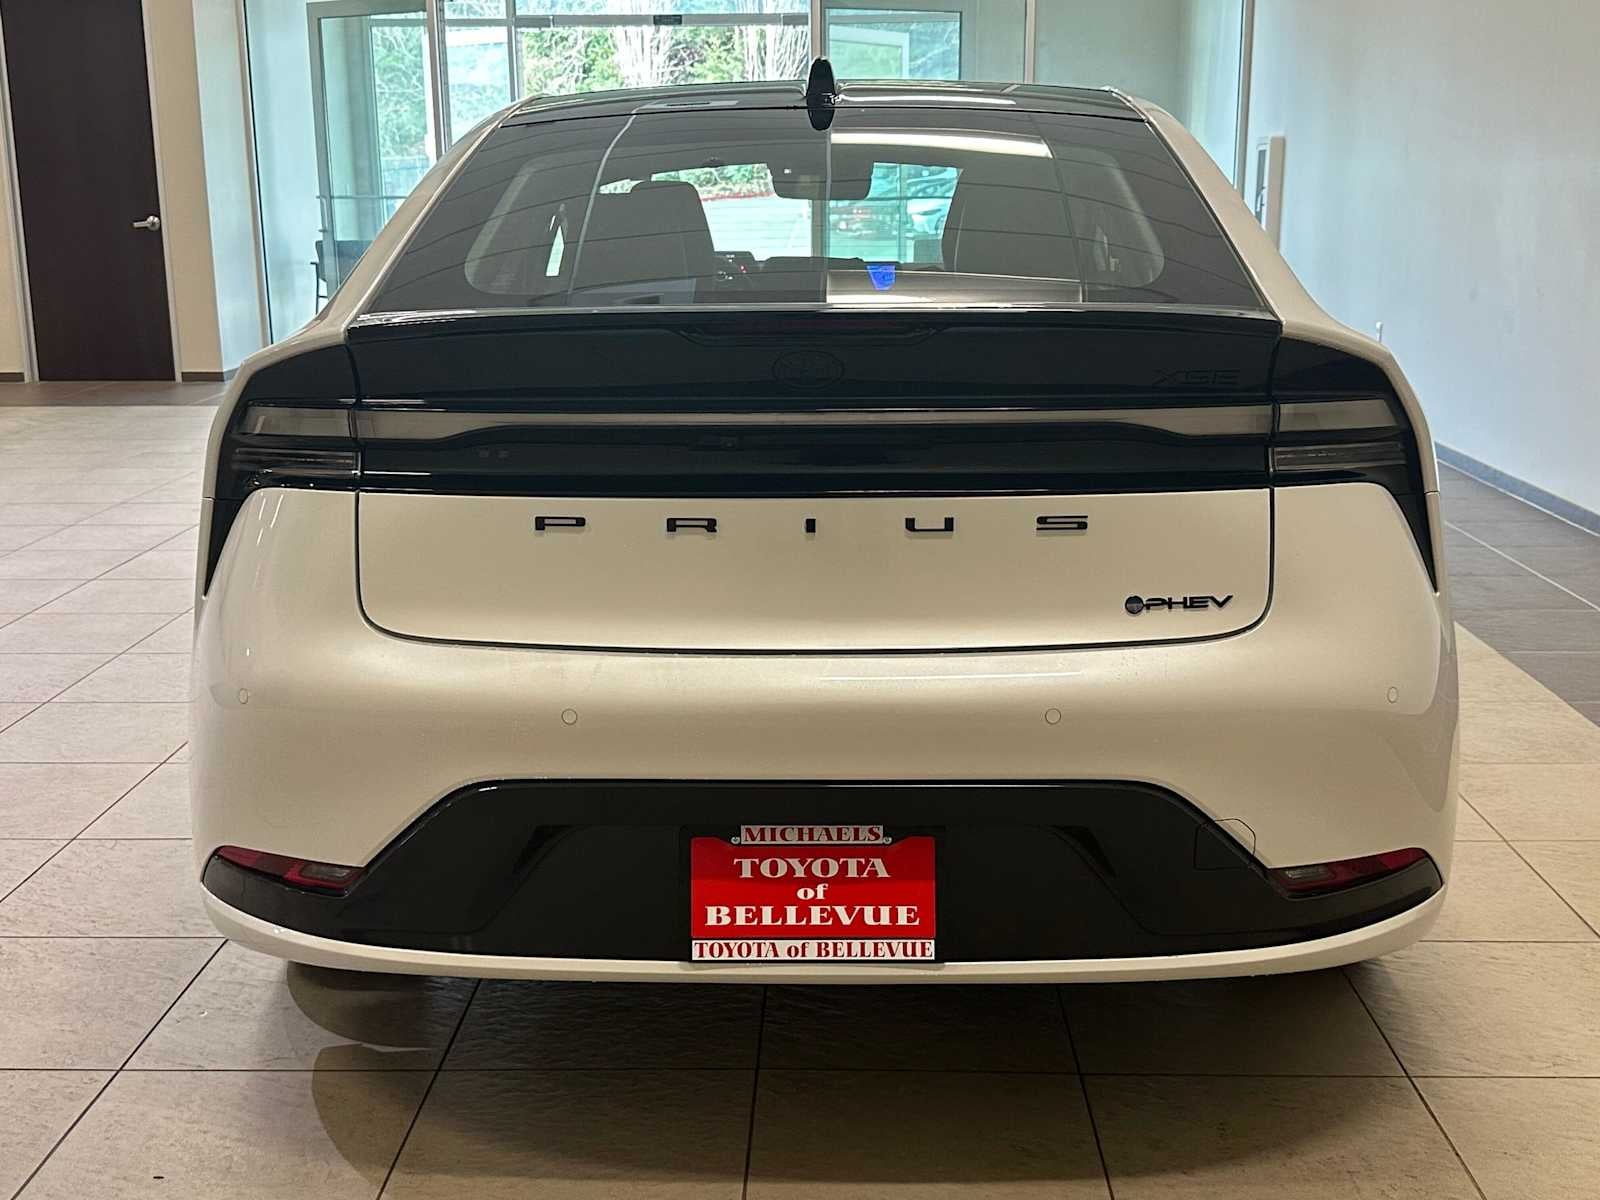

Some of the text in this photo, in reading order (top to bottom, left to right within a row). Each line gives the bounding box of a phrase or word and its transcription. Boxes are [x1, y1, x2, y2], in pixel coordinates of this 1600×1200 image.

[1153, 369, 1240, 385] XSE
[534, 515, 1089, 533] PRIUS
[1144, 595, 1233, 610] PHEV
[744, 827, 881, 842] MICHAELS
[733, 858, 891, 878] TOYOTA
[796, 883, 829, 900] of
[704, 905, 920, 926] BELLEVUE
[694, 942, 933, 958] TOYOTA of BELLEVUE
